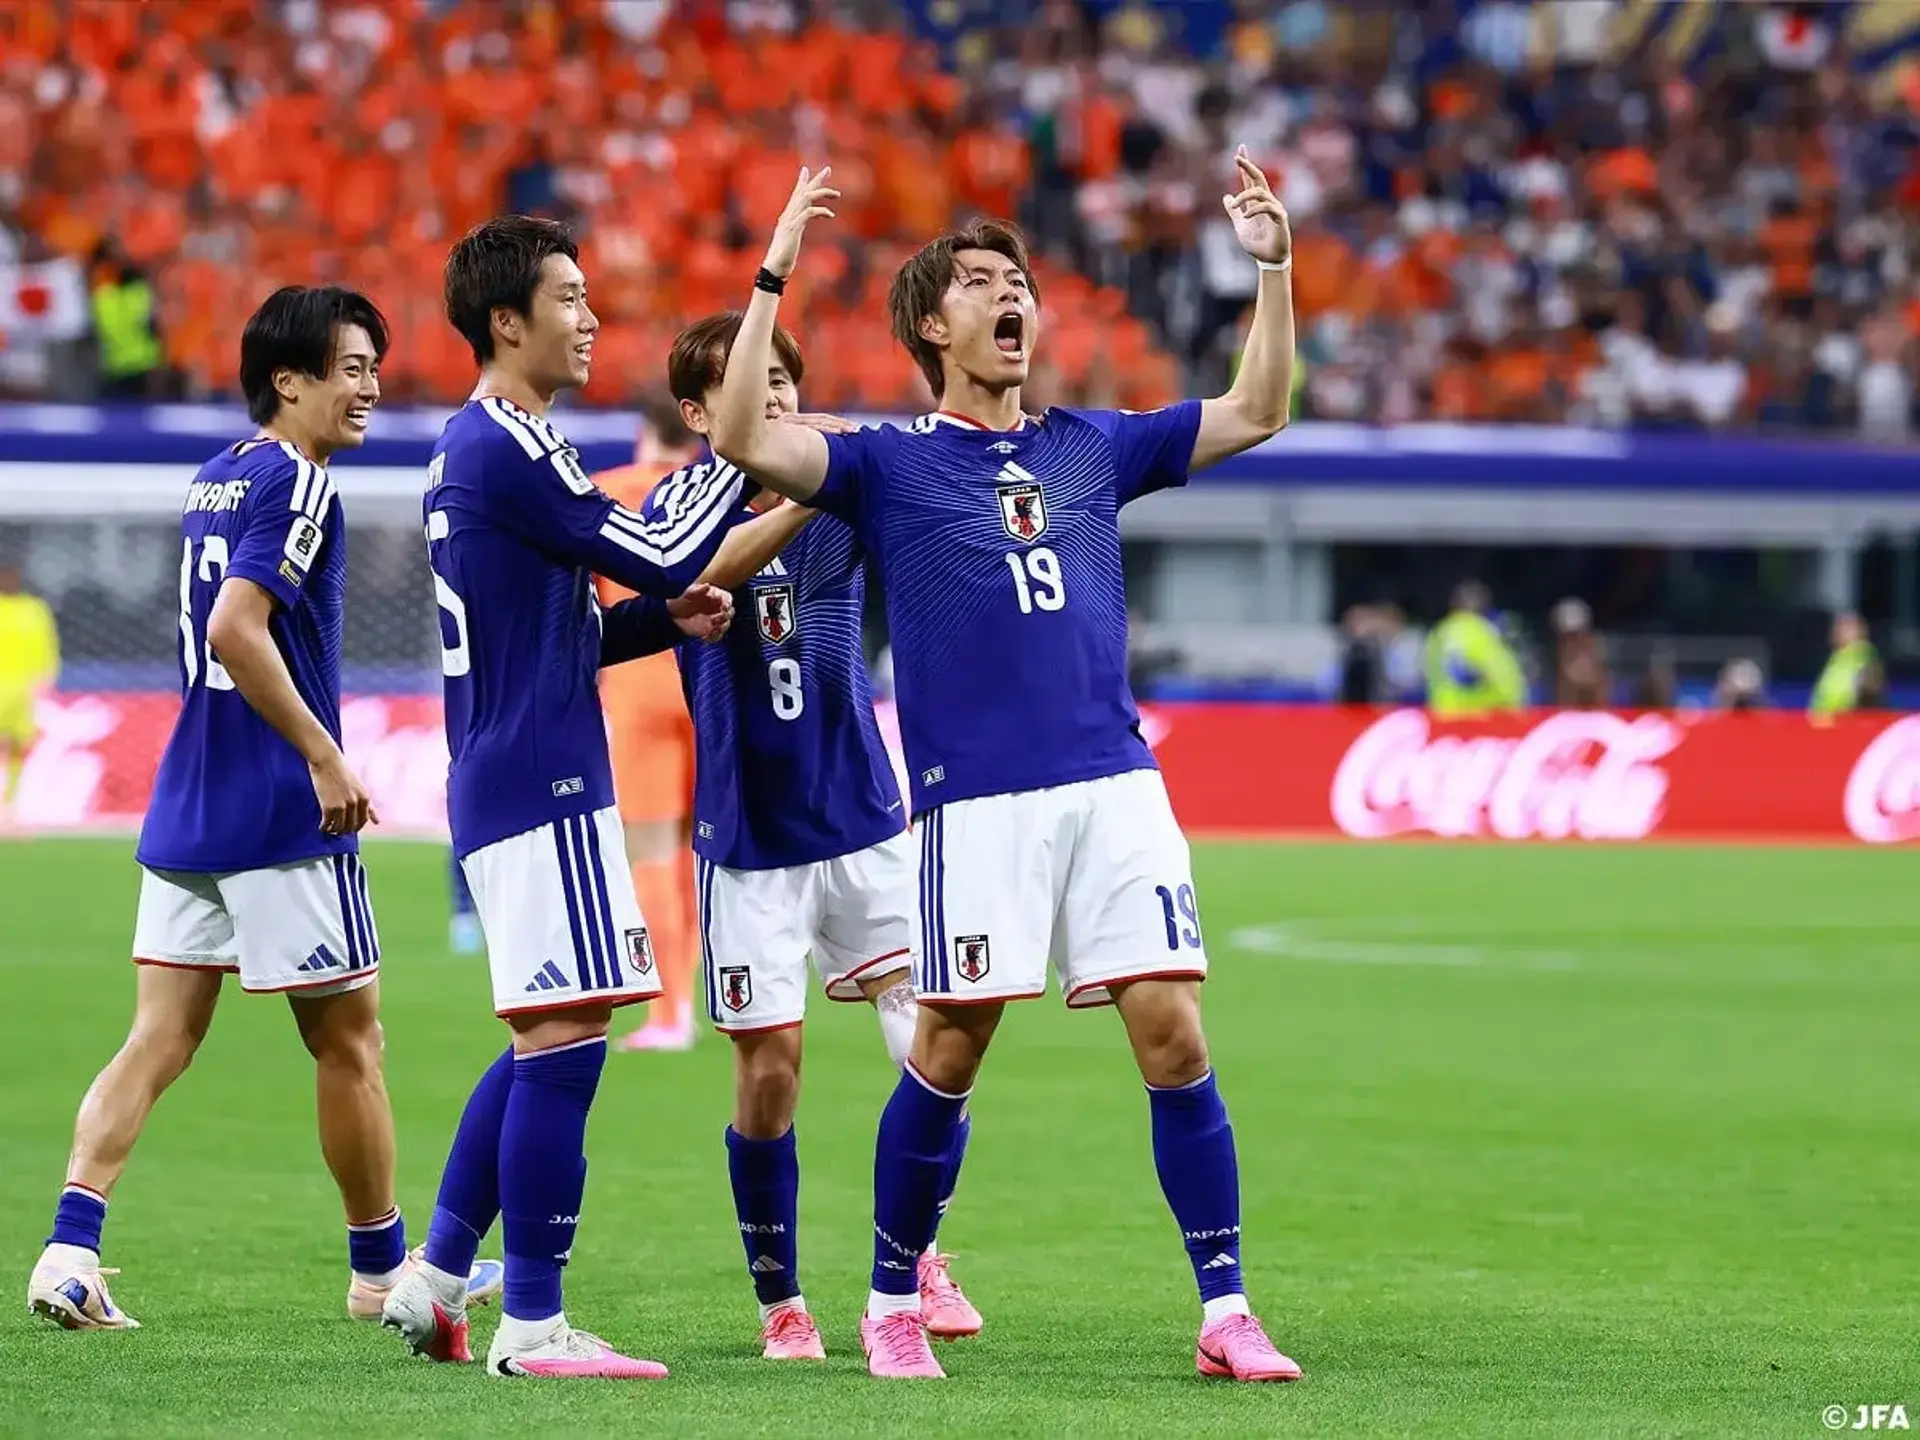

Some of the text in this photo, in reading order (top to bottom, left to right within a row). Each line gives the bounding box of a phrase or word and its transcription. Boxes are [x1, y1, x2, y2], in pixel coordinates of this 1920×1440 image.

[1005, 547, 1066, 615] 19
[768, 657, 805, 721] 8
[1155, 883, 1201, 951] 19
[740, 1221, 786, 1234] APAN
